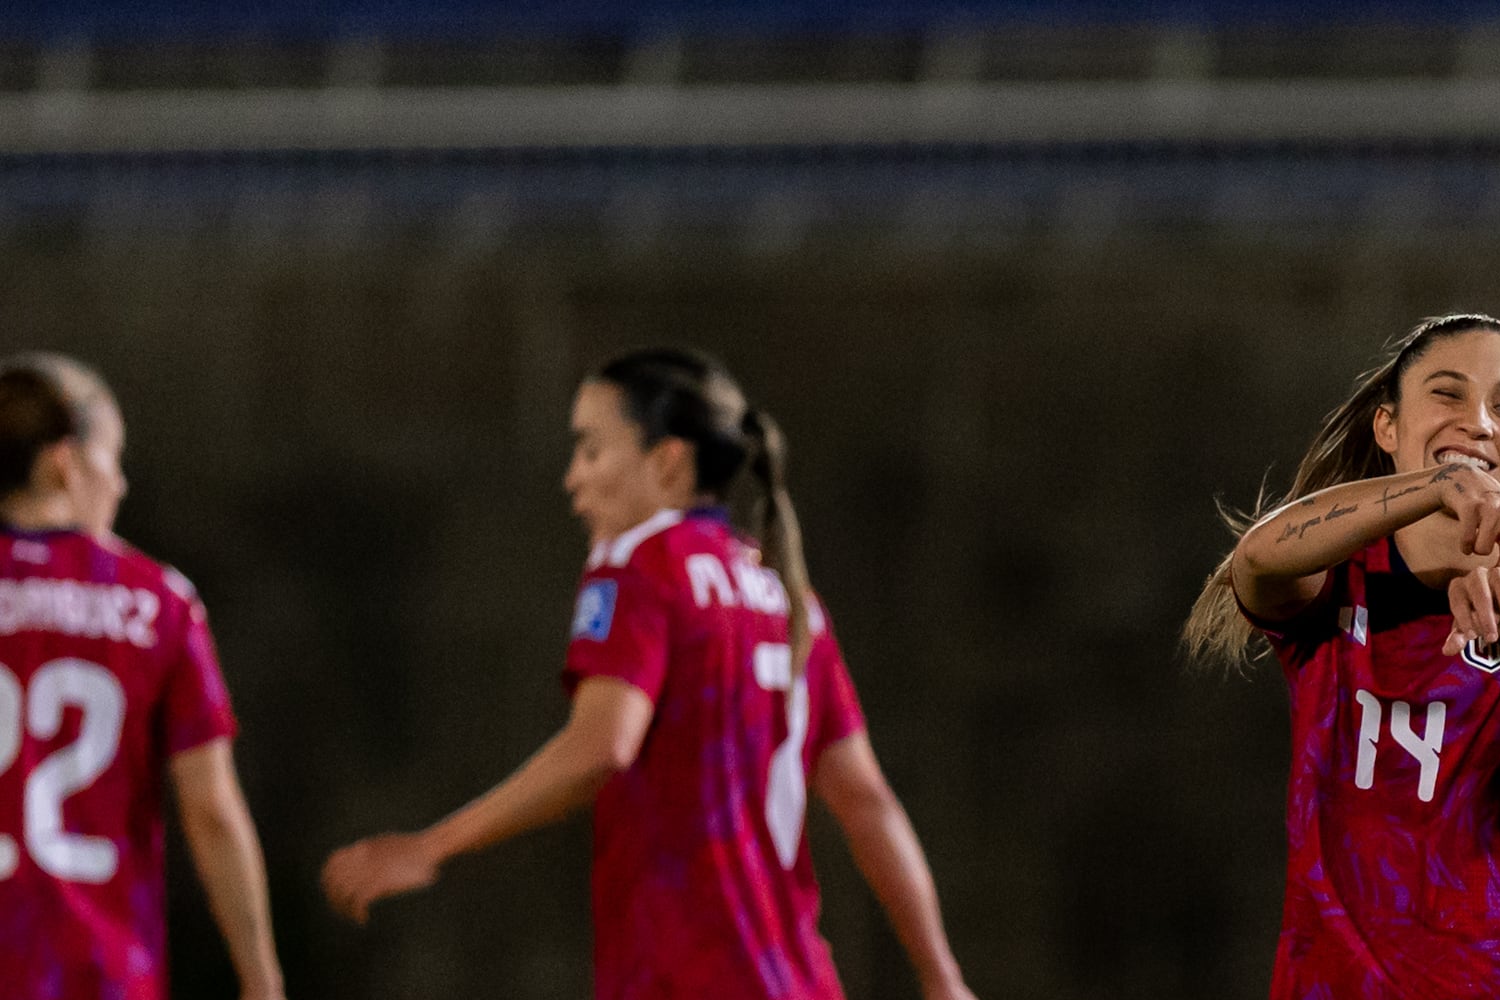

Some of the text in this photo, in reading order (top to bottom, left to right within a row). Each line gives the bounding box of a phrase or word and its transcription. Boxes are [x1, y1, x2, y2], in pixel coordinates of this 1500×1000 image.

[0, 656, 127, 885] 2
[752, 641, 810, 871] 7
[1355, 689, 1447, 802] 14
